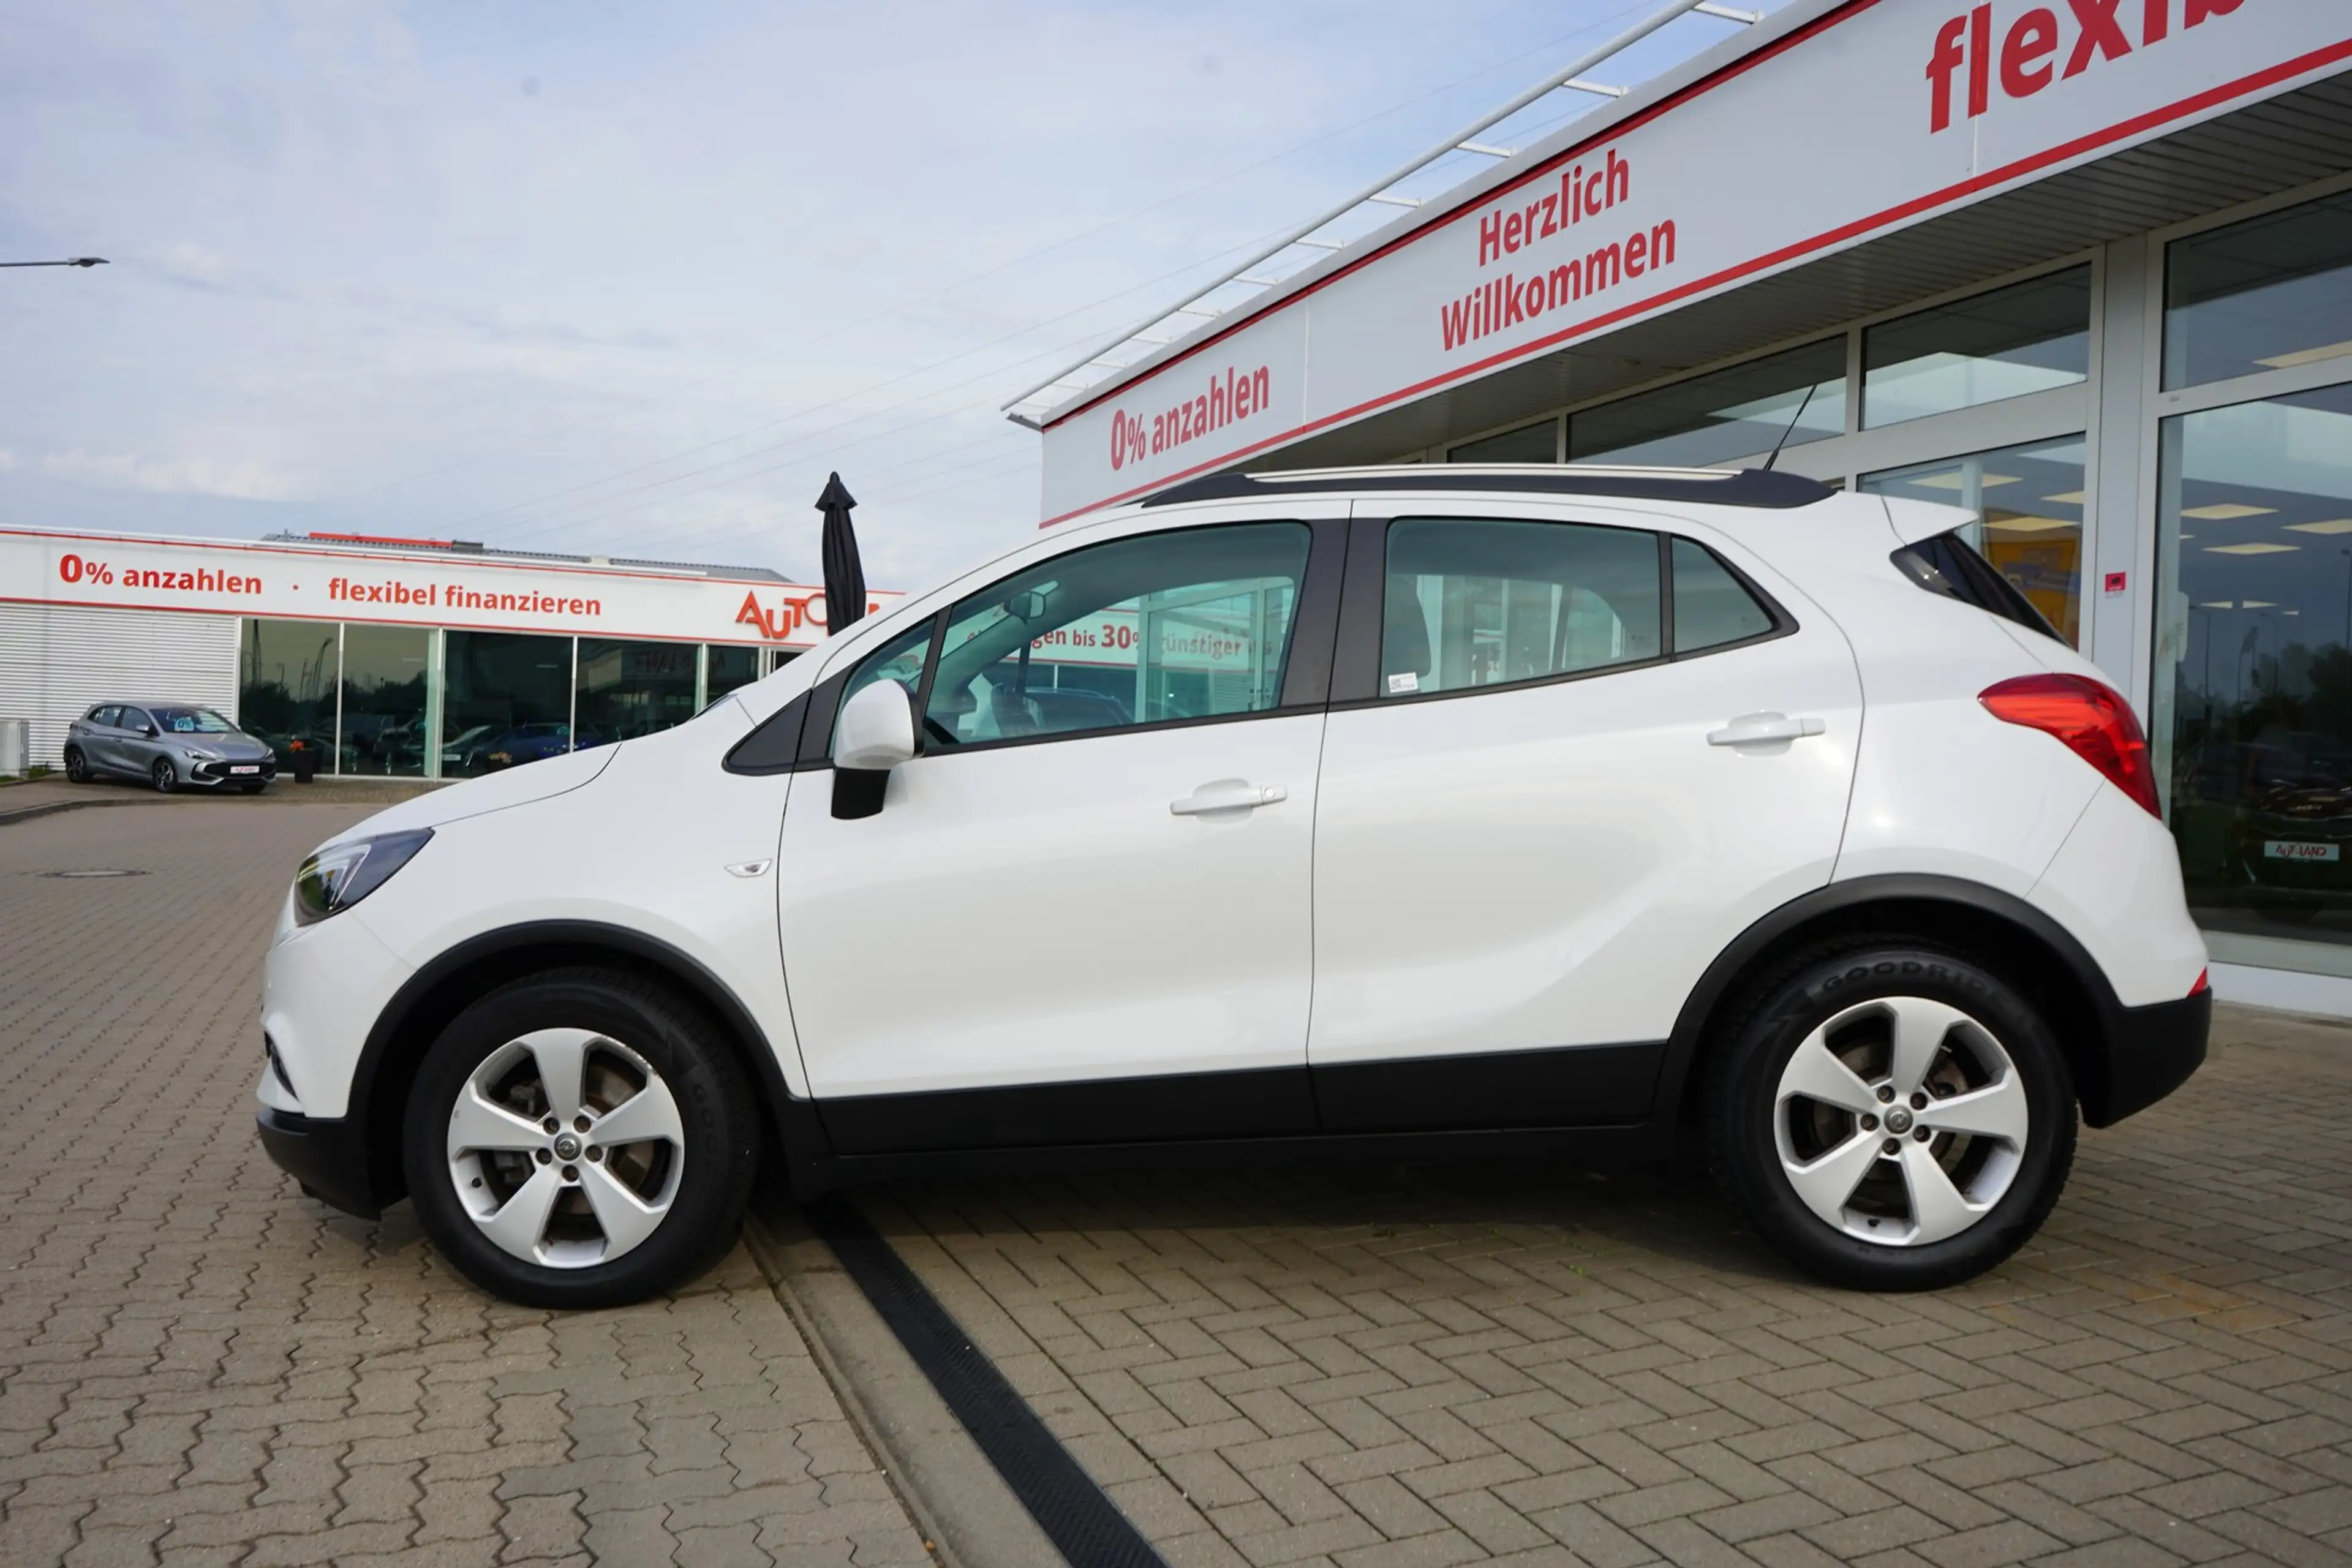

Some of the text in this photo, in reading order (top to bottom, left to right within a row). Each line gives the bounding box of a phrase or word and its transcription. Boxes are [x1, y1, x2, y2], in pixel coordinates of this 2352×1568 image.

[1479, 148, 1629, 267] Herzlich
[1441, 219, 1675, 352] Willkommen
[1110, 366, 1268, 470] 0% anzahlen
[59, 554, 601, 616] 0% anzahlen flexibel finanzieren
[1073, 630, 1095, 647] bis
[1162, 633, 1242, 661] ünstiger
